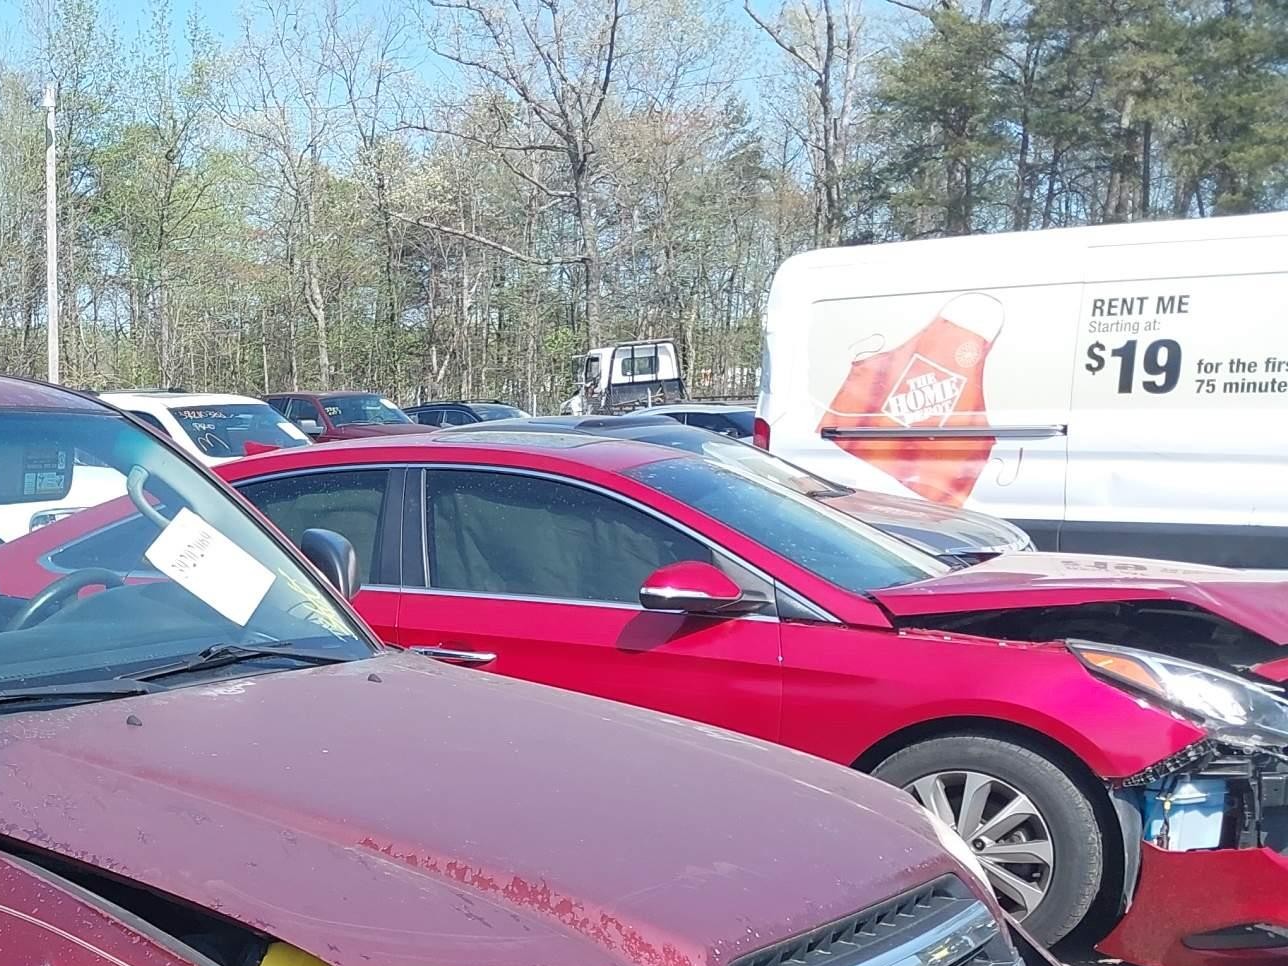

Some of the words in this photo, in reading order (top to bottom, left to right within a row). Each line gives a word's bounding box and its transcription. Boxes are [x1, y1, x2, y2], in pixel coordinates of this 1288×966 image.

[1091, 297, 1149, 317] RENT
[1156, 295, 1190, 315] ME
[1088, 320, 1140, 335] Starting
[1144, 319, 1161, 332] at:
[1085, 338, 1183, 394] $19
[1196, 359, 1223, 374] for
[1229, 358, 1258, 374] the
[906, 372, 937, 391] THE
[1195, 379, 1216, 394] 75
[889, 376, 960, 416] HOME
